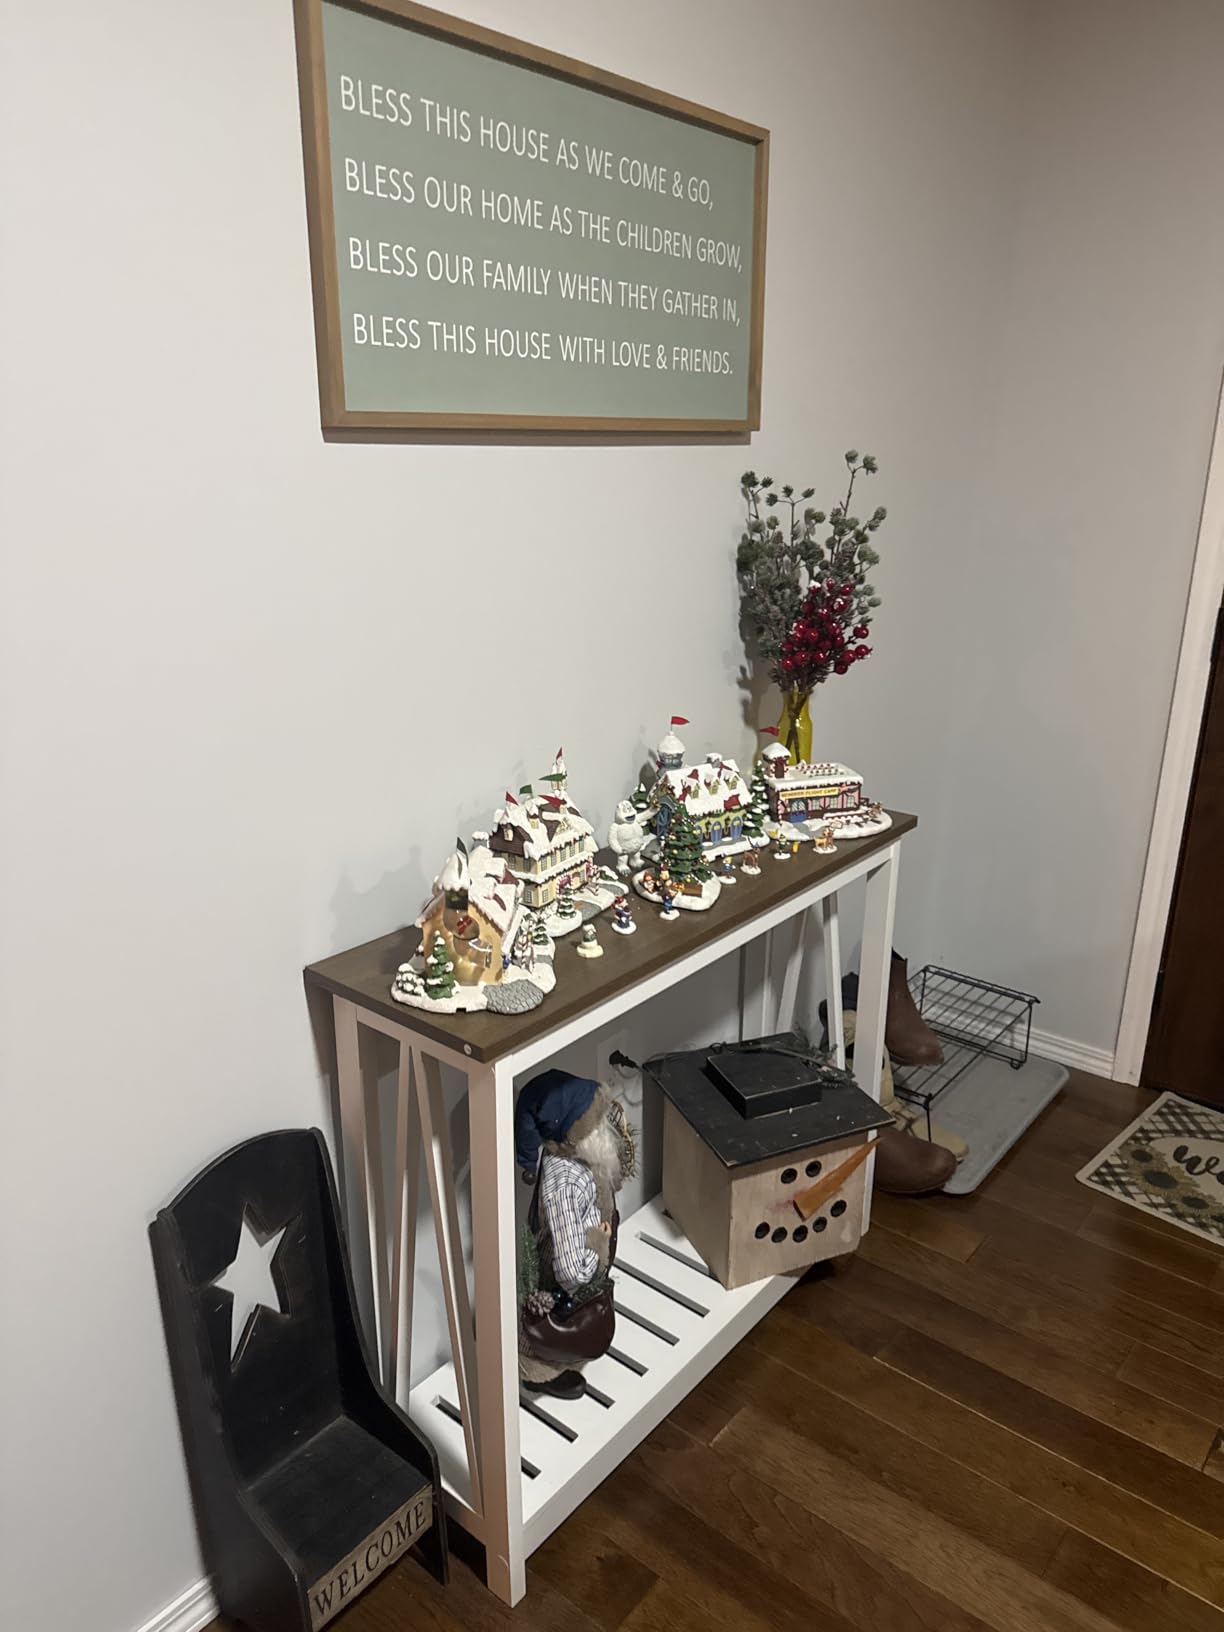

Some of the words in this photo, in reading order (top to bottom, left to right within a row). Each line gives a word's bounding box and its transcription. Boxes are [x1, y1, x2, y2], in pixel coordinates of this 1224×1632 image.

[341, 75, 412, 126] BLESS
[420, 98, 471, 142] THIS
[481, 116, 549, 162] HOUSE
[556, 139, 578, 170] AS
[585, 145, 613, 179] WE
[619, 157, 666, 194] COME
[672, 171, 683, 199] &
[688, 177, 712, 210] GO,
[345, 158, 415, 203] BLESS
[424, 177, 472, 216] OUR
[482, 189, 543, 229] HOME
[550, 205, 572, 235] AS
[578, 210, 610, 243] THE
[617, 220, 691, 259] CHILDREN
[697, 238, 741, 272] GROW,
[349, 237, 417, 277] BLESS
[427, 251, 474, 286] OUR
[484, 260, 551, 295] FAMILY
[558, 271, 612, 304] WHEN
[618, 281, 658, 310] THEY
[663, 289, 717, 319] GATHER
[723, 298, 740, 326] IN,
[354, 314, 420, 349] BLESS
[427, 321, 476, 354] THIS
[486, 328, 551, 359] HOUSE
[559, 335, 604, 364] WITH
[613, 341, 650, 368] LOVE
[657, 345, 667, 369] &
[673, 347, 732, 374] FRIENDS.
[314, 1501, 426, 1616] WELCOME
